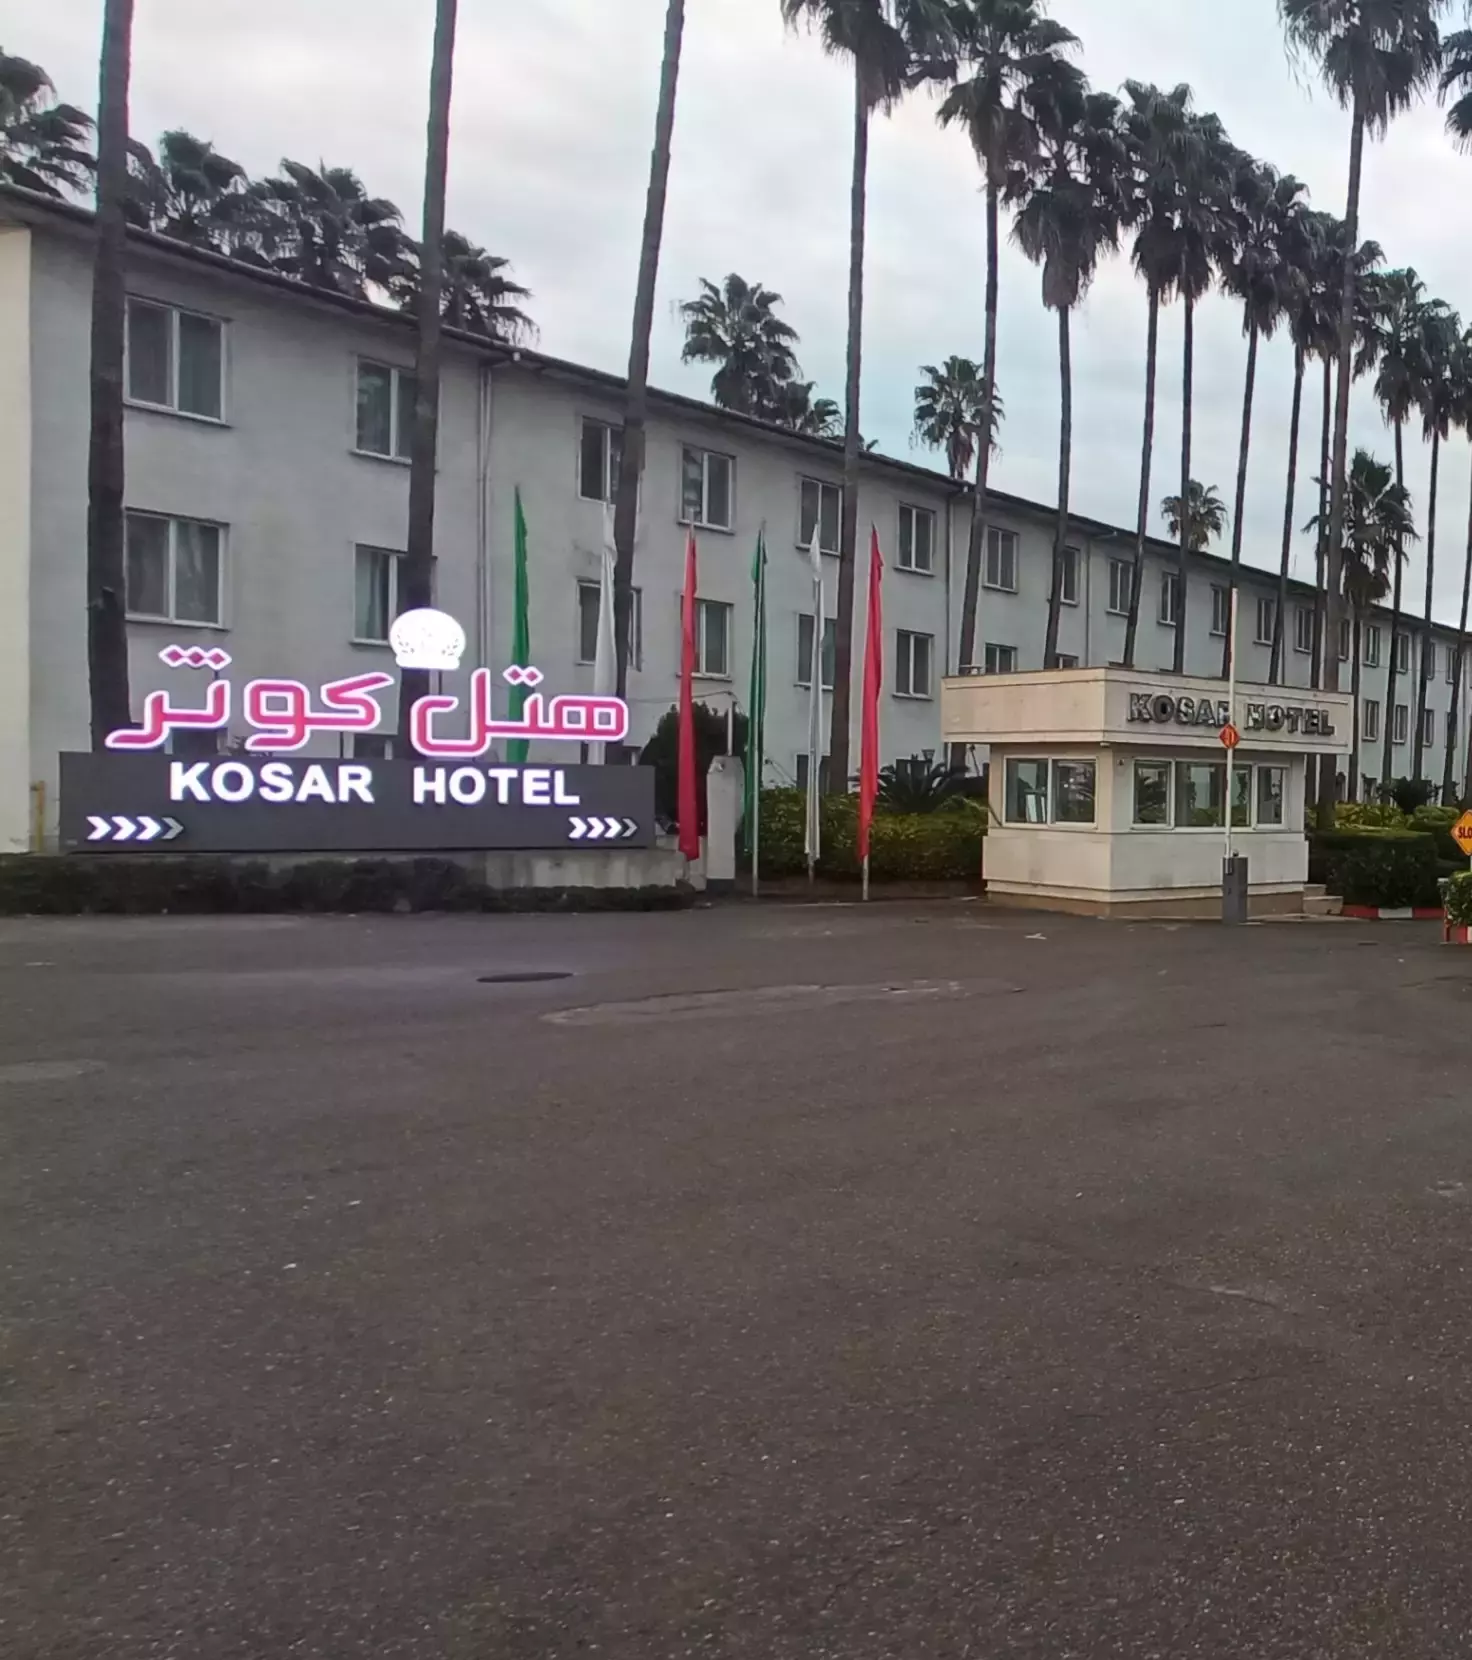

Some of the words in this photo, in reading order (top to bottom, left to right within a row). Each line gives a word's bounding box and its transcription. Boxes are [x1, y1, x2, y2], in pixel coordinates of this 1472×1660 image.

[105, 644, 394, 751] کوثر
[410, 665, 629, 757] هتل
[1243, 703, 1335, 736] HOTEL
[170, 761, 375, 804] KOSAR
[413, 766, 580, 805] HOTEL
